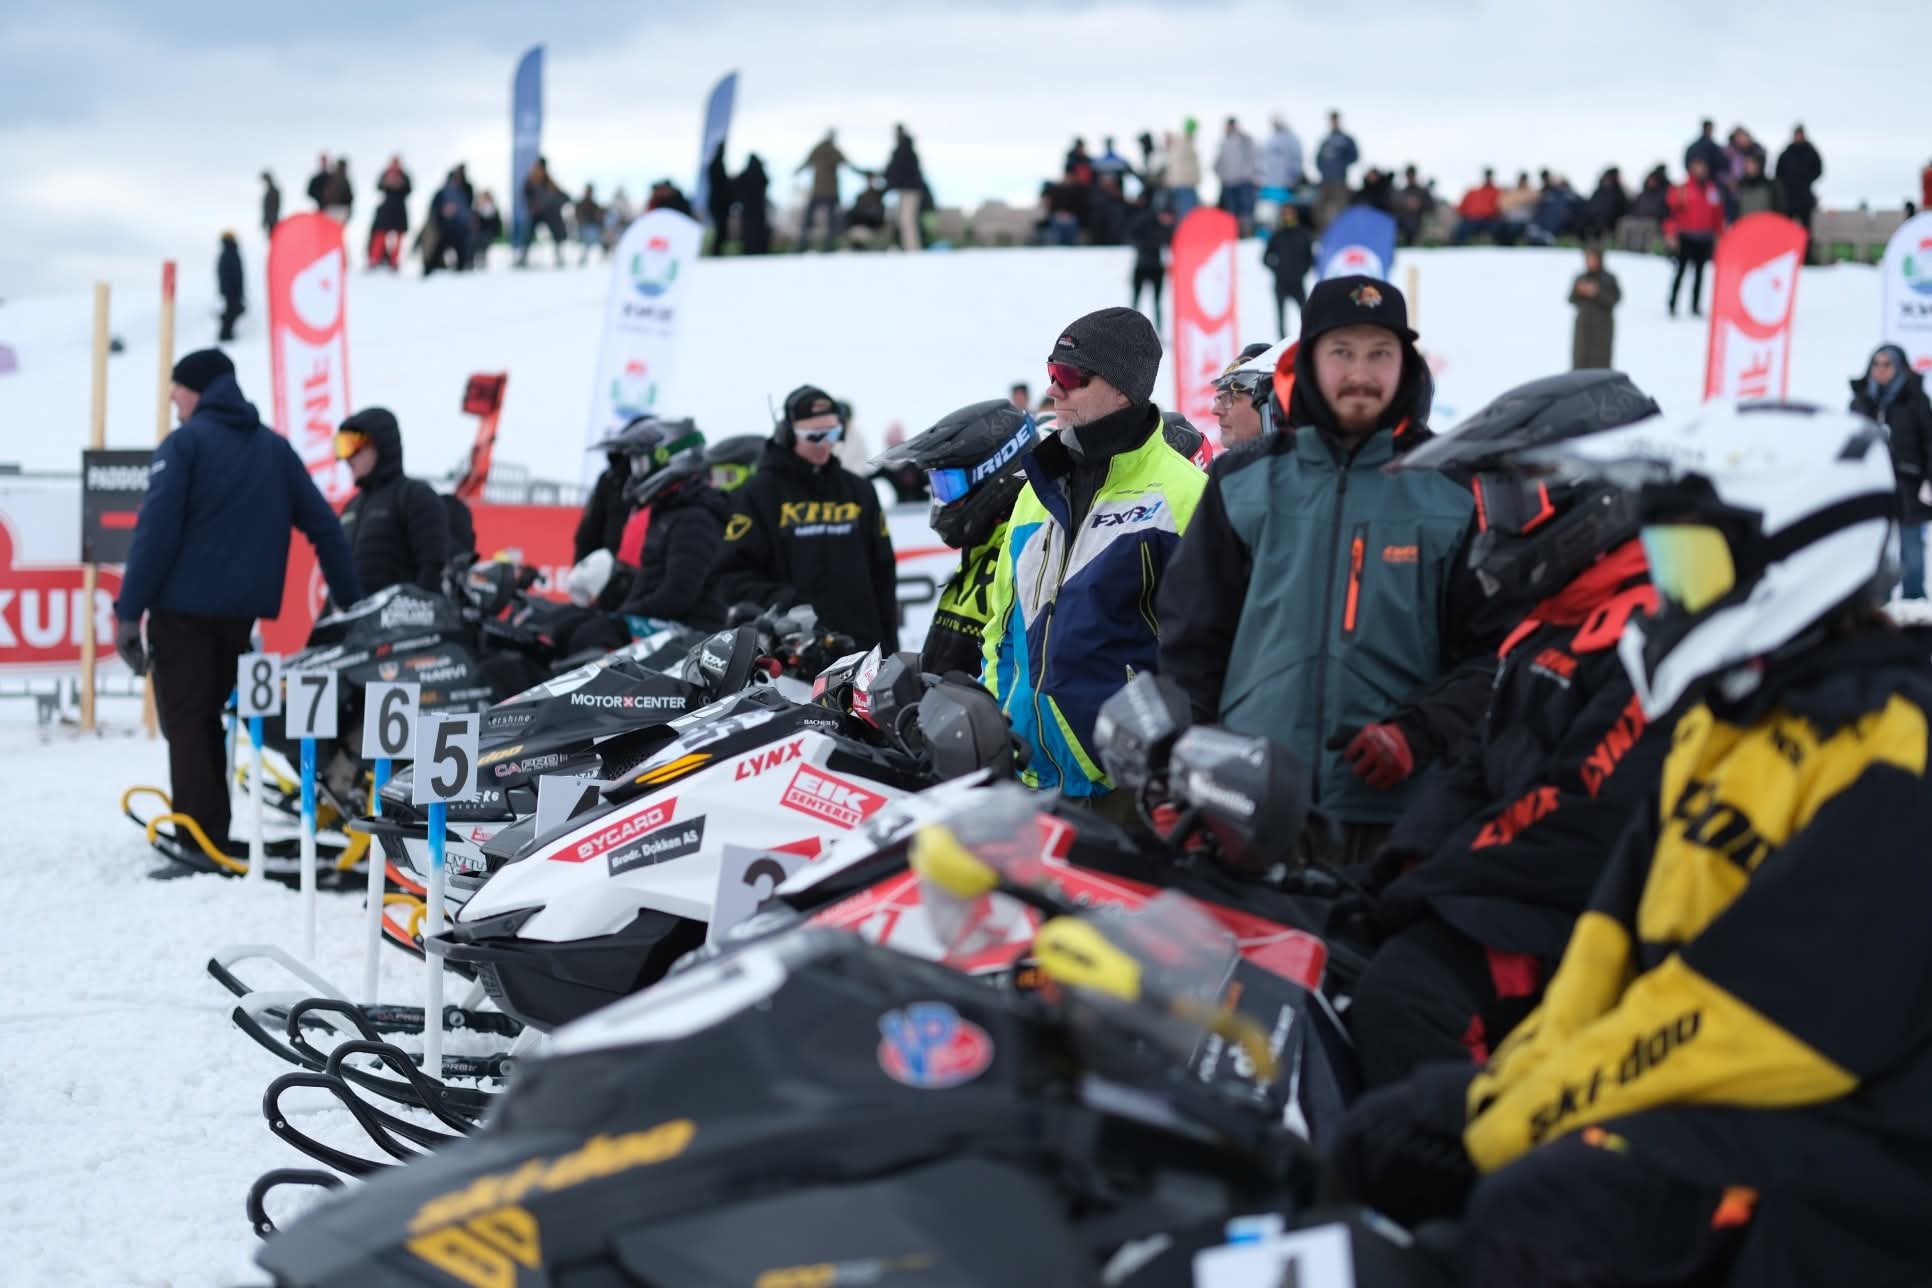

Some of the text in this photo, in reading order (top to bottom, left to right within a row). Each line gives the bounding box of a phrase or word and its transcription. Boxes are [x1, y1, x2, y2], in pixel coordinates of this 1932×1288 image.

[88, 465, 150, 491] PADDOC
[251, 660, 274, 710] 8
[301, 676, 328, 732] 7
[379, 688, 410, 754] 6
[430, 720, 469, 798] 5
[735, 738, 805, 782] LYNX
[790, 791, 858, 824] SENTERET
[792, 772, 870, 813] EIK
[683, 829, 698, 844] AS
[1472, 786, 1559, 849] LYNX
